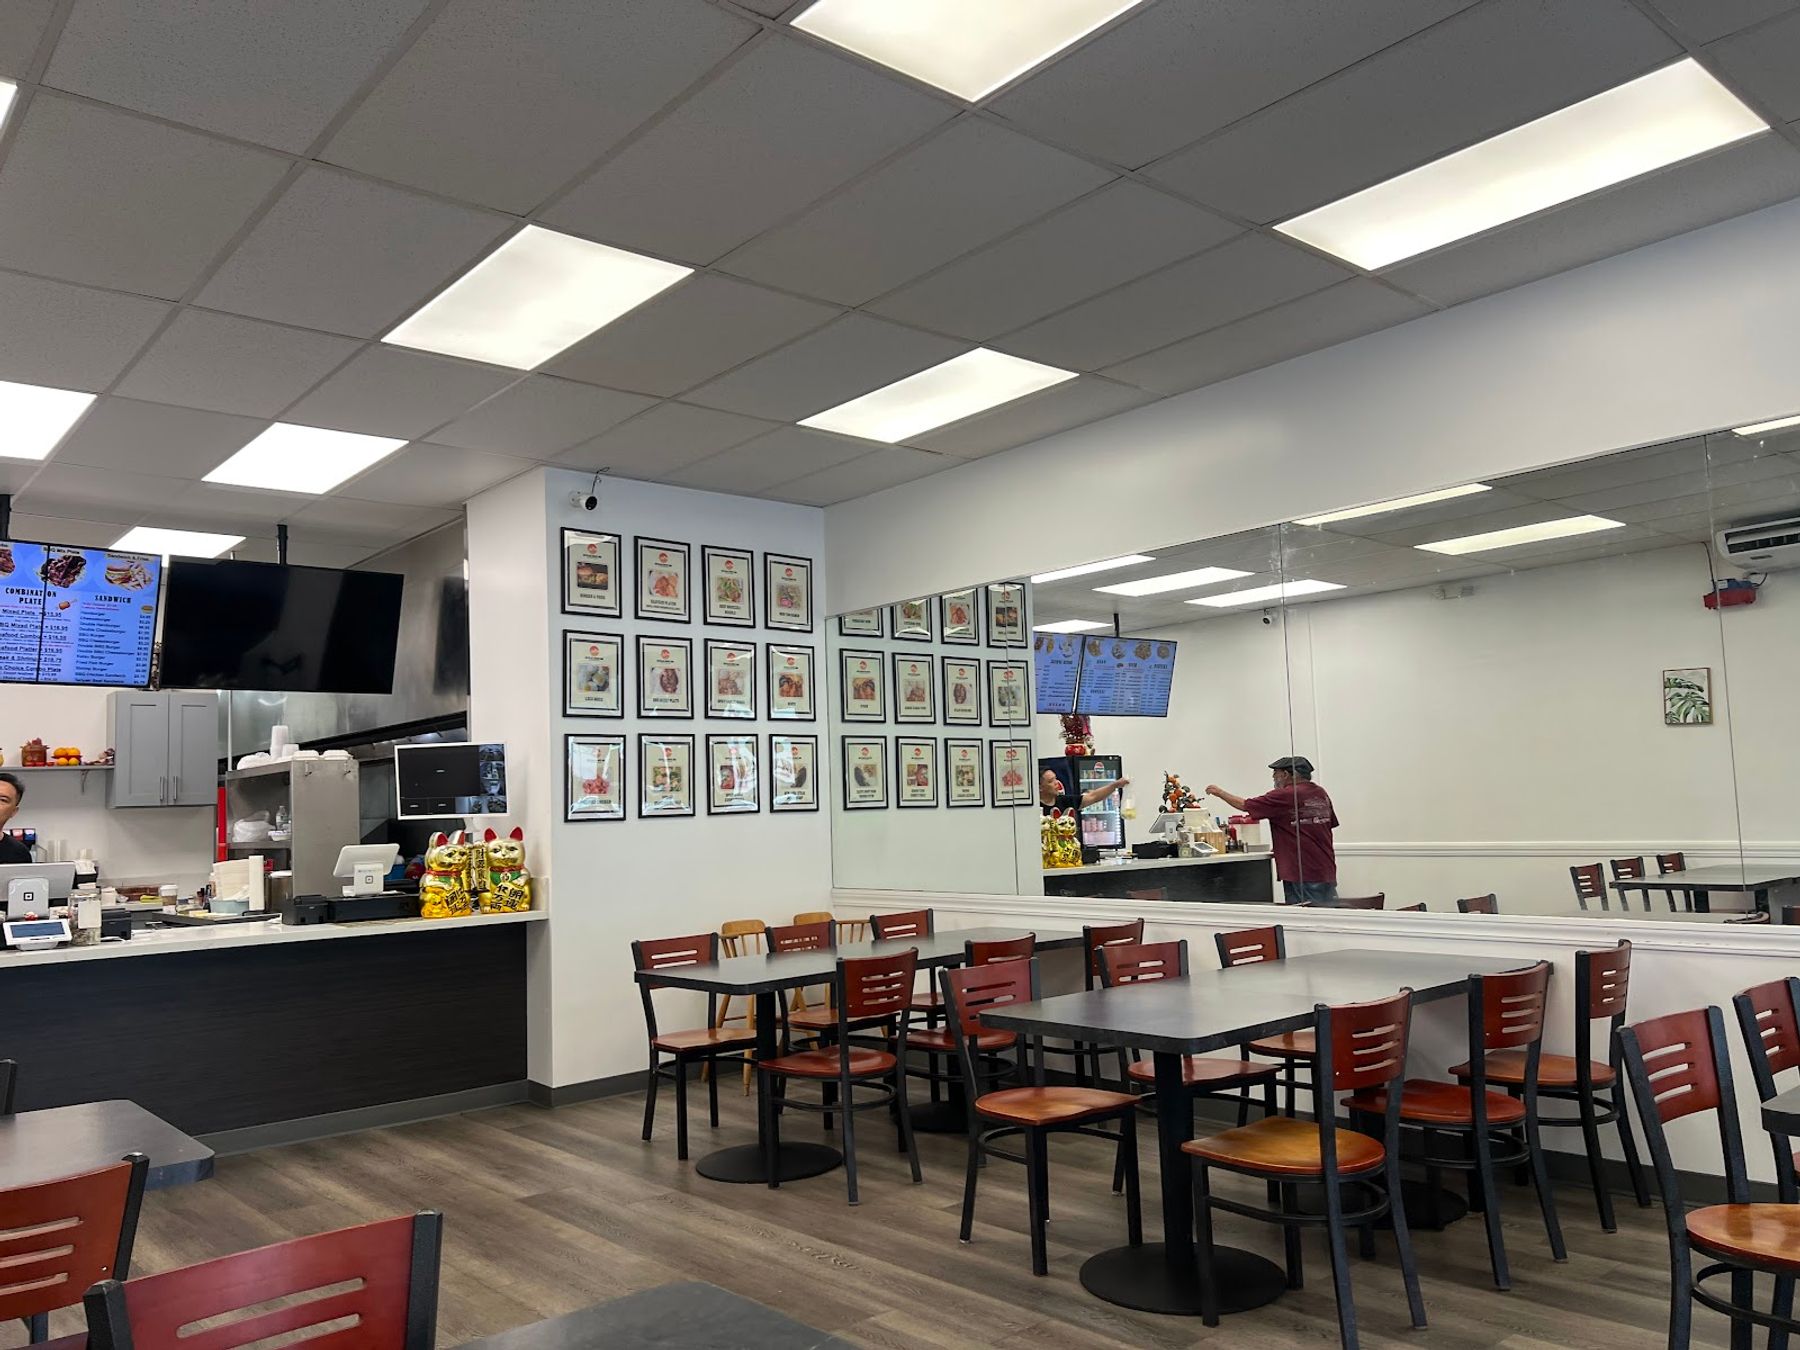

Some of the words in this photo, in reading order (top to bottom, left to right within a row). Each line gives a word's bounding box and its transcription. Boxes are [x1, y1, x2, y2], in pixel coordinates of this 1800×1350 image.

[5, 587, 57, 597] COMBINATON
[19, 597, 42, 606] PLATE
[94, 594, 132, 604] SANDWICH
